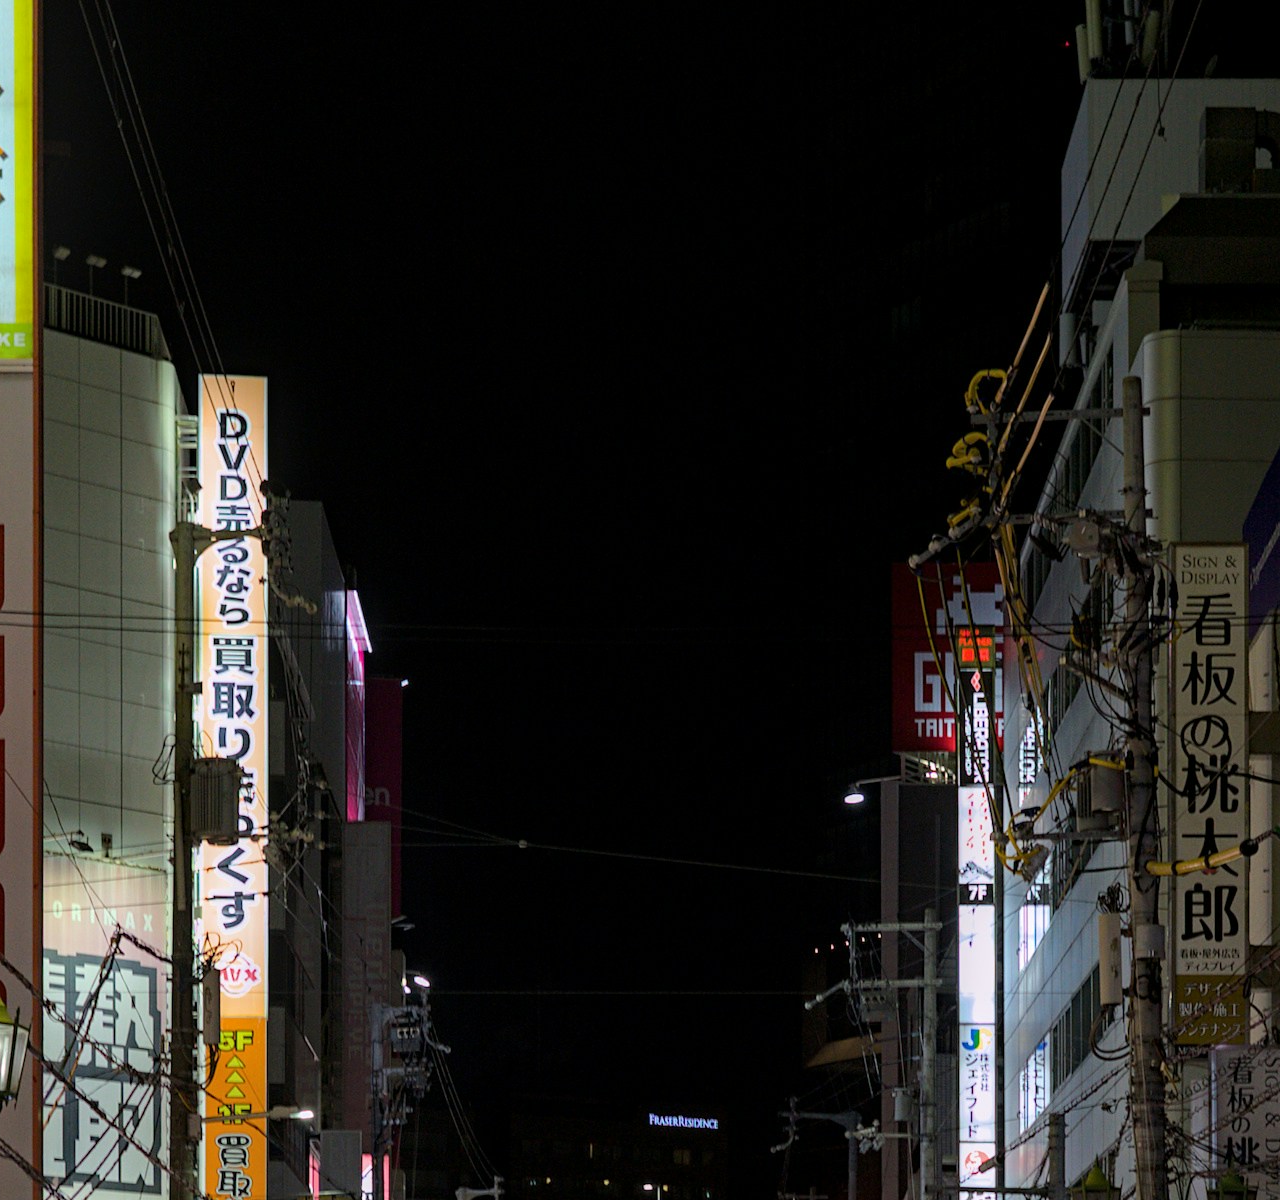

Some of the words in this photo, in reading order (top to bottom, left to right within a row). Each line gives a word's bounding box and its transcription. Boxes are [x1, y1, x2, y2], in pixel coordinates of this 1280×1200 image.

[1224, 556, 1237, 568] &
[1181, 570, 1240, 586] DISPLAY
[1181, 593, 1239, 943] 看板の桃太郎
[968, 884, 988, 901] 7F
